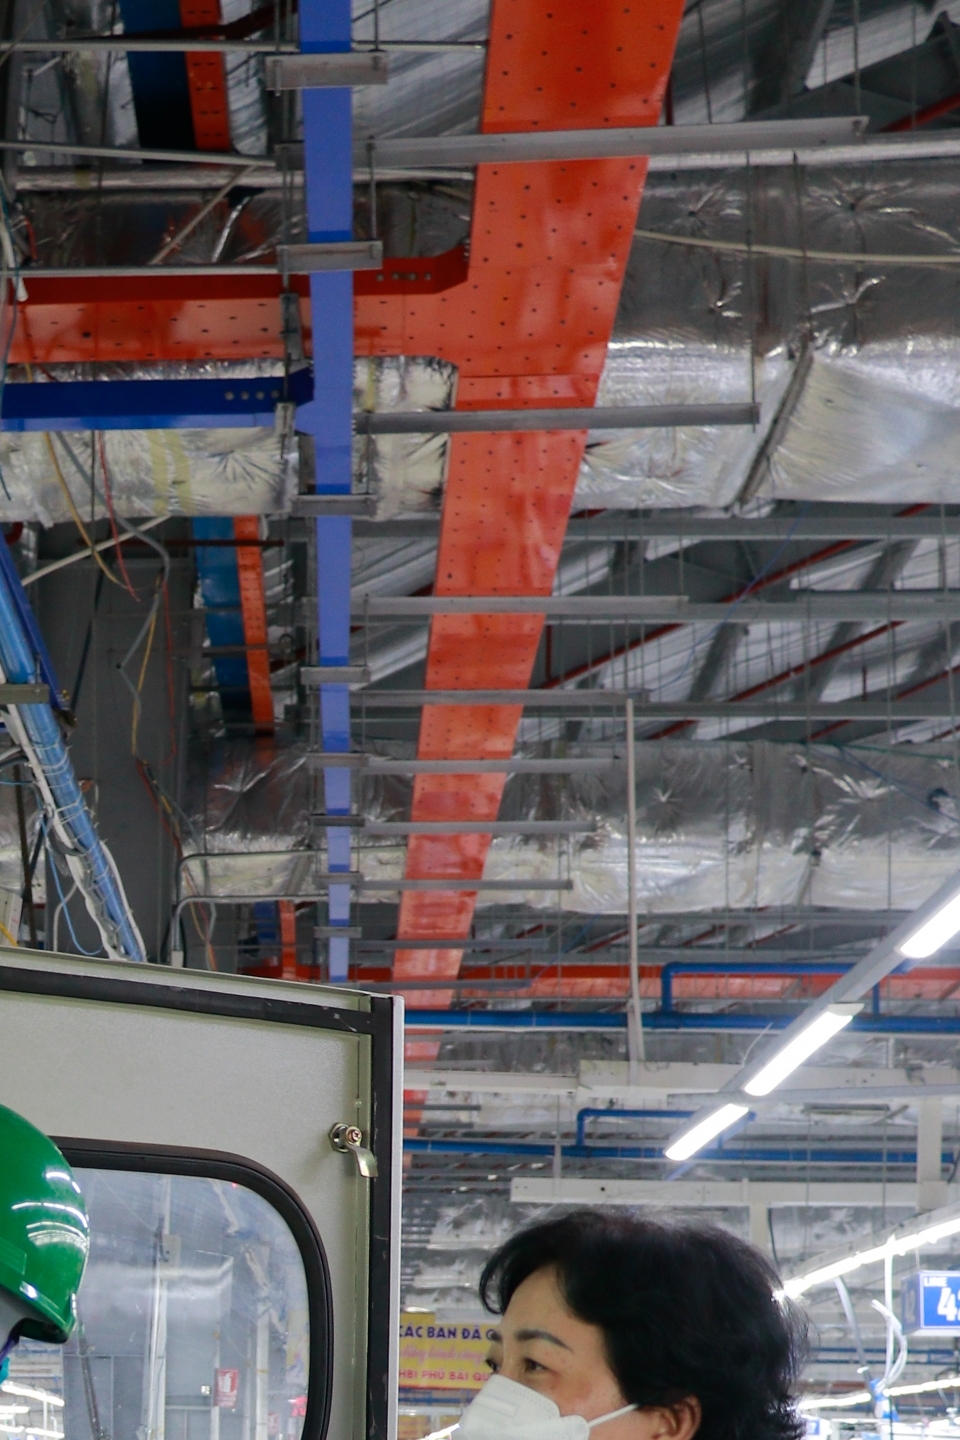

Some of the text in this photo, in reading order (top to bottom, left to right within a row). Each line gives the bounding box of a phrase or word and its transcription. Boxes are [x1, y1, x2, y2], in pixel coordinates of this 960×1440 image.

[923, 1276, 947, 1287] LINE
[936, 1287, 960, 1321] 4
[400, 1322, 423, 1338] ÁC
